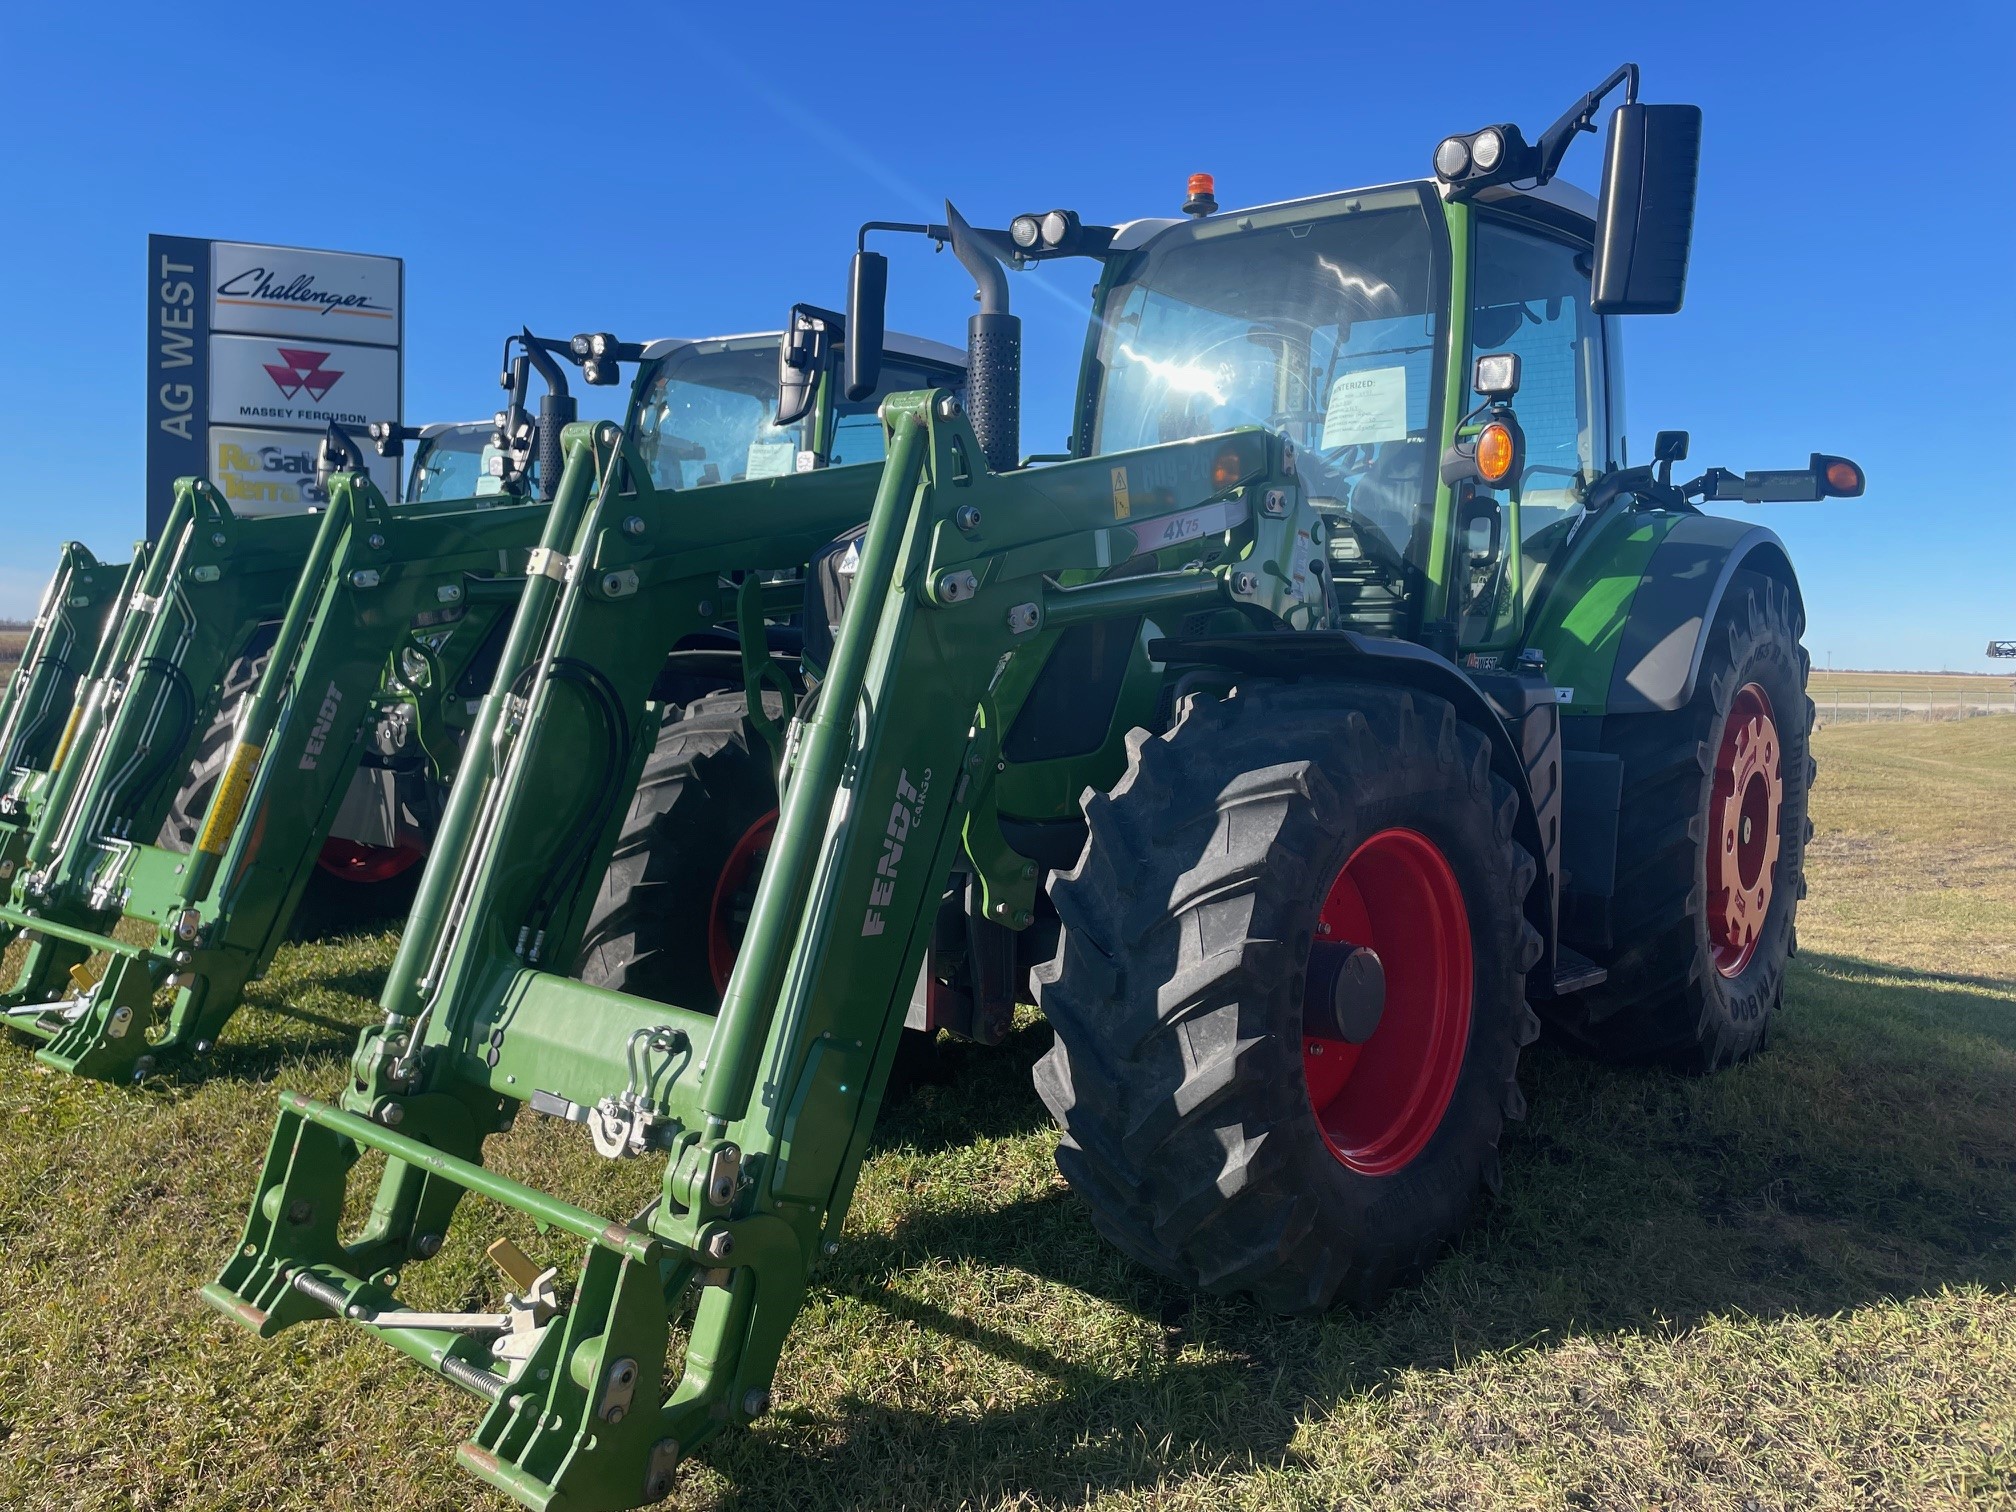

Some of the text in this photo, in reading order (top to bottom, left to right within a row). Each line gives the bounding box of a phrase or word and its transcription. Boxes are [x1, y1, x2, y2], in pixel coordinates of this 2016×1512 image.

[217, 268, 393, 315] Challenger
[160, 254, 194, 441] AG WEST
[240, 406, 366, 423] MASSEY FERGUSON
[298, 680, 342, 769] FENDT
[912, 768, 932, 828] CARGO
[1785, 726, 1804, 886] TRELLEBORG
[861, 768, 918, 936] FENDT
